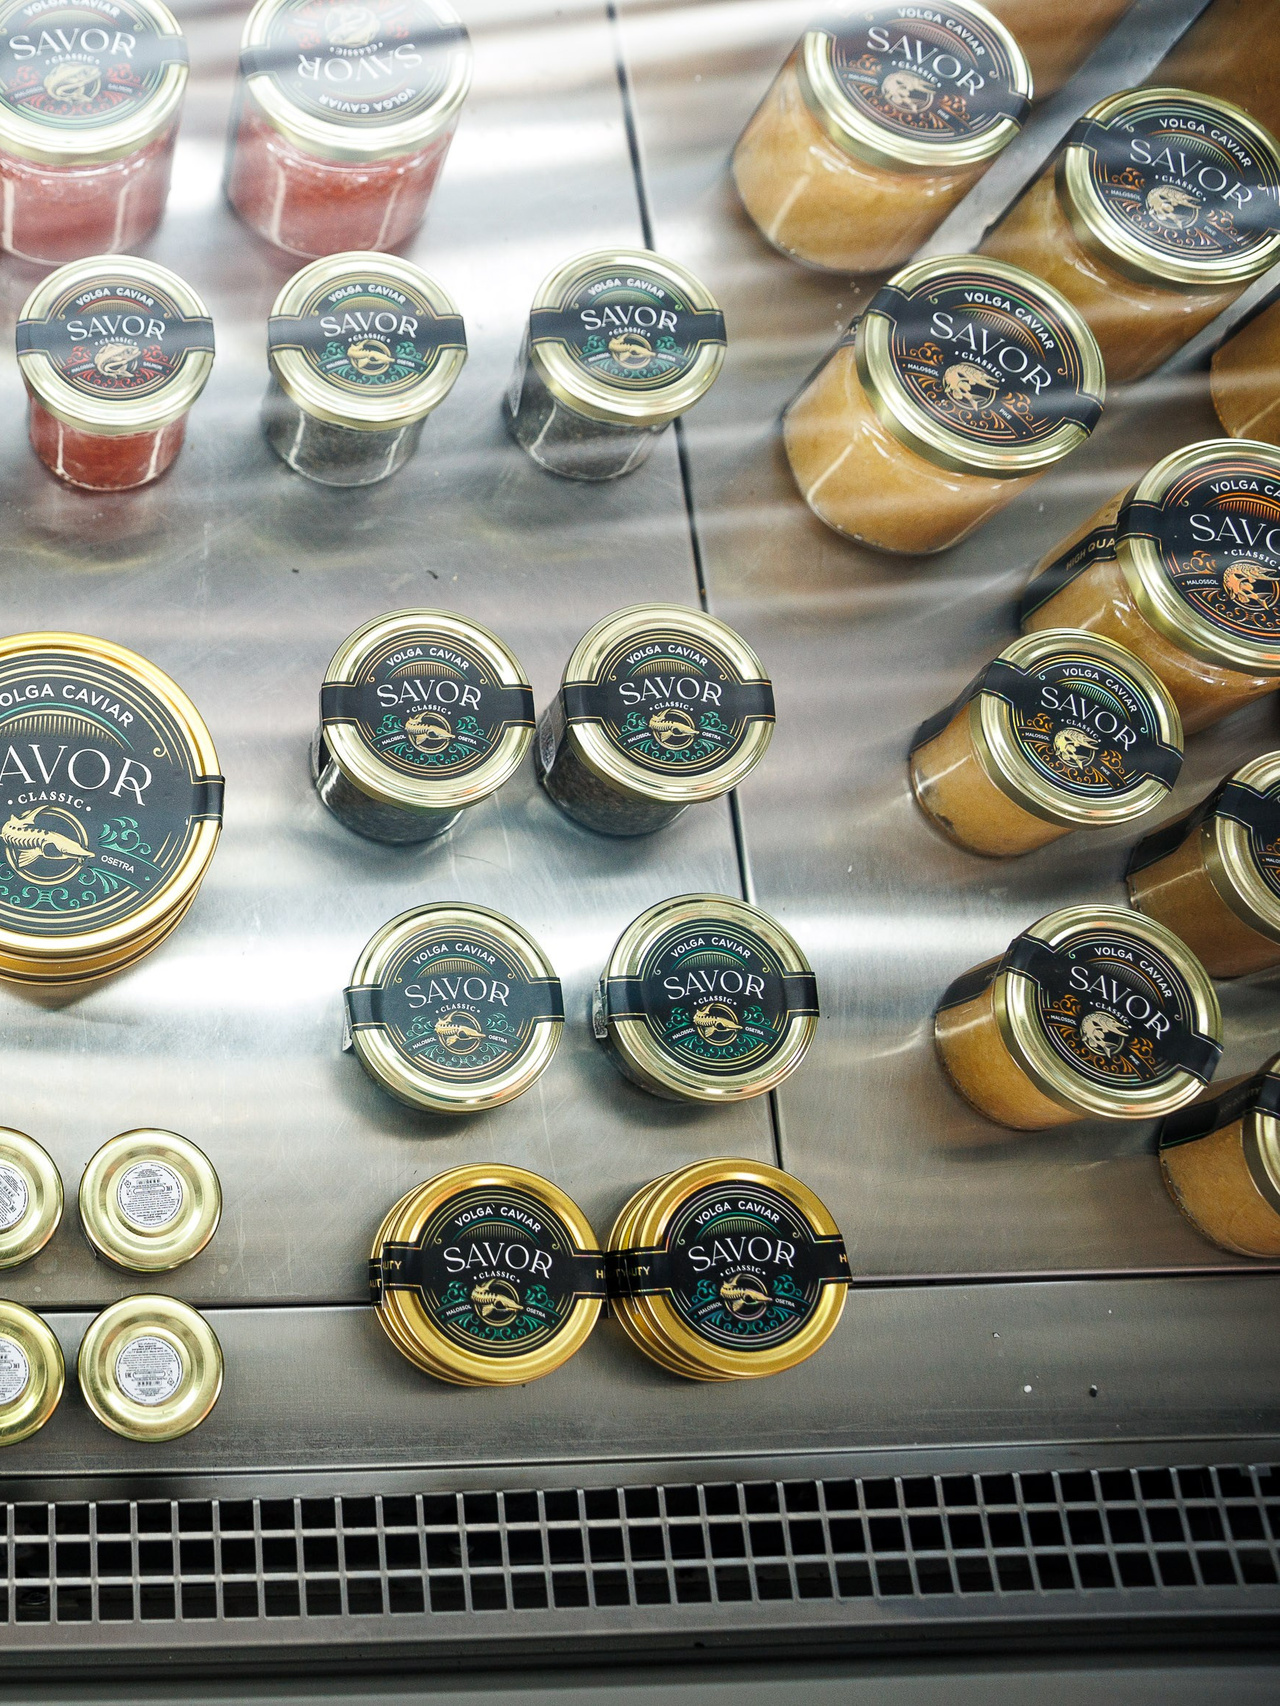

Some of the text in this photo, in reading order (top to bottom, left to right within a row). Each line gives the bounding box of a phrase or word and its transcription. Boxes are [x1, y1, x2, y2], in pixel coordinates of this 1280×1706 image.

[9, 28, 136, 60] SAVOR
[898, 8, 985, 57] VOLGA CAVIAR
[298, 43, 422, 82] SAVOR
[867, 26, 985, 96] SAVOR
[899, 61, 936, 84] CLASSIC
[319, 88, 415, 113] VOLGA CAVIAR
[1159, 118, 1252, 167] VOLGA CAVIAR
[1130, 138, 1252, 210] SAVOR
[1162, 175, 1203, 197] CLASSIC
[76, 287, 154, 307] VOLGA CAVIAR
[328, 285, 406, 304] VOLGA CAVIAR
[588, 278, 665, 298] VOLGA CAVIAR
[67, 315, 165, 341] SAVOR
[320, 312, 418, 338] SAVOR
[581, 306, 677, 333] SAVOR
[964, 292, 1055, 350] VOLGA CAVIAR
[99, 337, 133, 345] CLASSIC
[353, 334, 386, 342] CLASSIC
[930, 312, 1051, 395] SAVOR
[961, 352, 1002, 377] CLASSIC
[1210, 480, 1259, 494] VOLGA
[1231, 549, 1276, 567] CLASSIC
[386, 647, 469, 670] VOLGA CAVIAR
[627, 645, 708, 667] VOLGA CAVIAR
[377, 680, 481, 710] SAVOR
[619, 677, 722, 706] SAVOR
[1063, 668, 1138, 713] VOLGA CAVIAR
[62, 685, 134, 728] CAVIAR
[412, 704, 447, 714] CLASSIC
[654, 701, 689, 710] CLASSIC
[1040, 687, 1137, 751] SAVOR
[1066, 719, 1097, 740] CLASSIC
[458, 735, 477, 745] OSETRA
[702, 732, 721, 740] OSETRA
[18, 791, 84, 808] CLASSIC
[101, 855, 135, 873] OSETRA
[413, 943, 496, 965] VOLGA CAVIAR
[671, 937, 751, 959] VOLGA CAVIAR
[1094, 947, 1172, 998] VOLGA CAVIAR
[404, 977, 509, 1009] SAVOR
[664, 970, 765, 1000] SAVOR
[441, 1003, 476, 1012] CLASSIC
[698, 996, 733, 1005] CLASSIC
[1069, 966, 1170, 1040] SAVOR
[1096, 1002, 1128, 1025] CLASSIC
[488, 1034, 508, 1043] OSETRA
[745, 1027, 764, 1036] OSETRA
[455, 1207, 541, 1233] VOLGA CAVIAR
[695, 1200, 780, 1225] VOLGA CAVIAR
[443, 1242, 552, 1279] SAVOR
[688, 1236, 795, 1272] SAVOR
[479, 1270, 516, 1280] CLASSIC
[725, 1265, 761, 1275] CLASSIC
[526, 1307, 546, 1318] OSETRA
[775, 1298, 795, 1308] OSETRA
